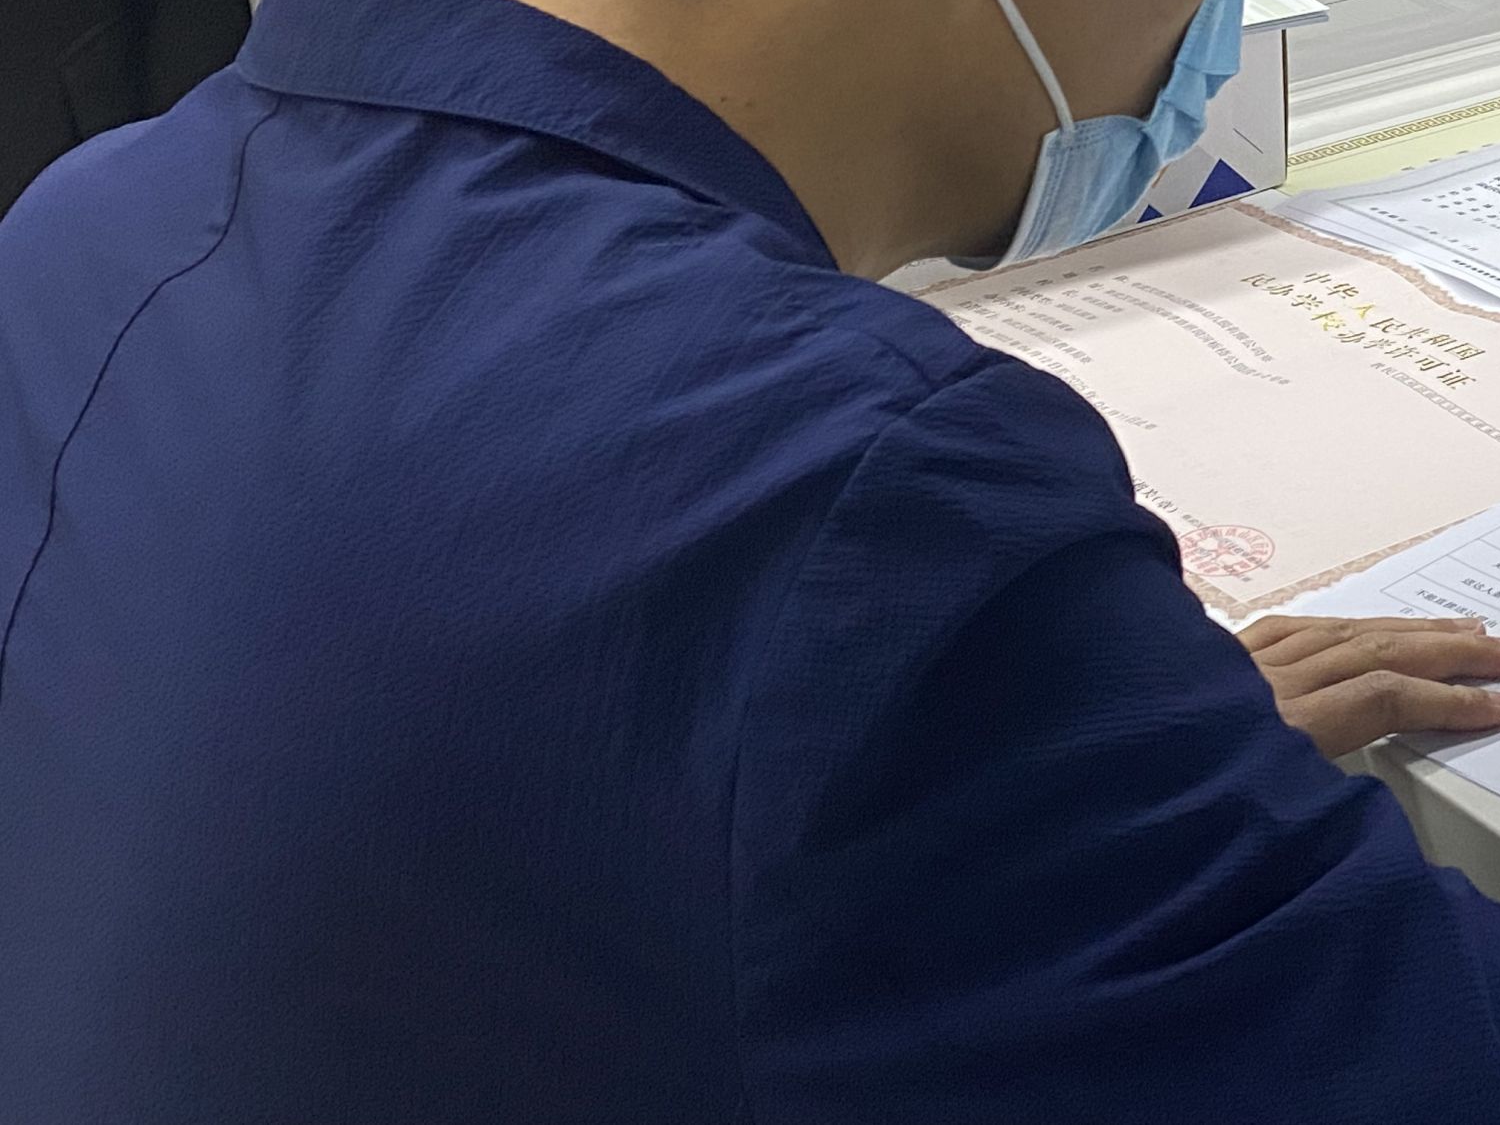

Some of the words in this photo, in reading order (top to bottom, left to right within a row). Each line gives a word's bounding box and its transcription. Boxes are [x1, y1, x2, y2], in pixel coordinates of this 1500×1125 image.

[1240, 273, 1478, 391] 民办学校办学许可证
[1303, 273, 1487, 361] 中华人民共和国
